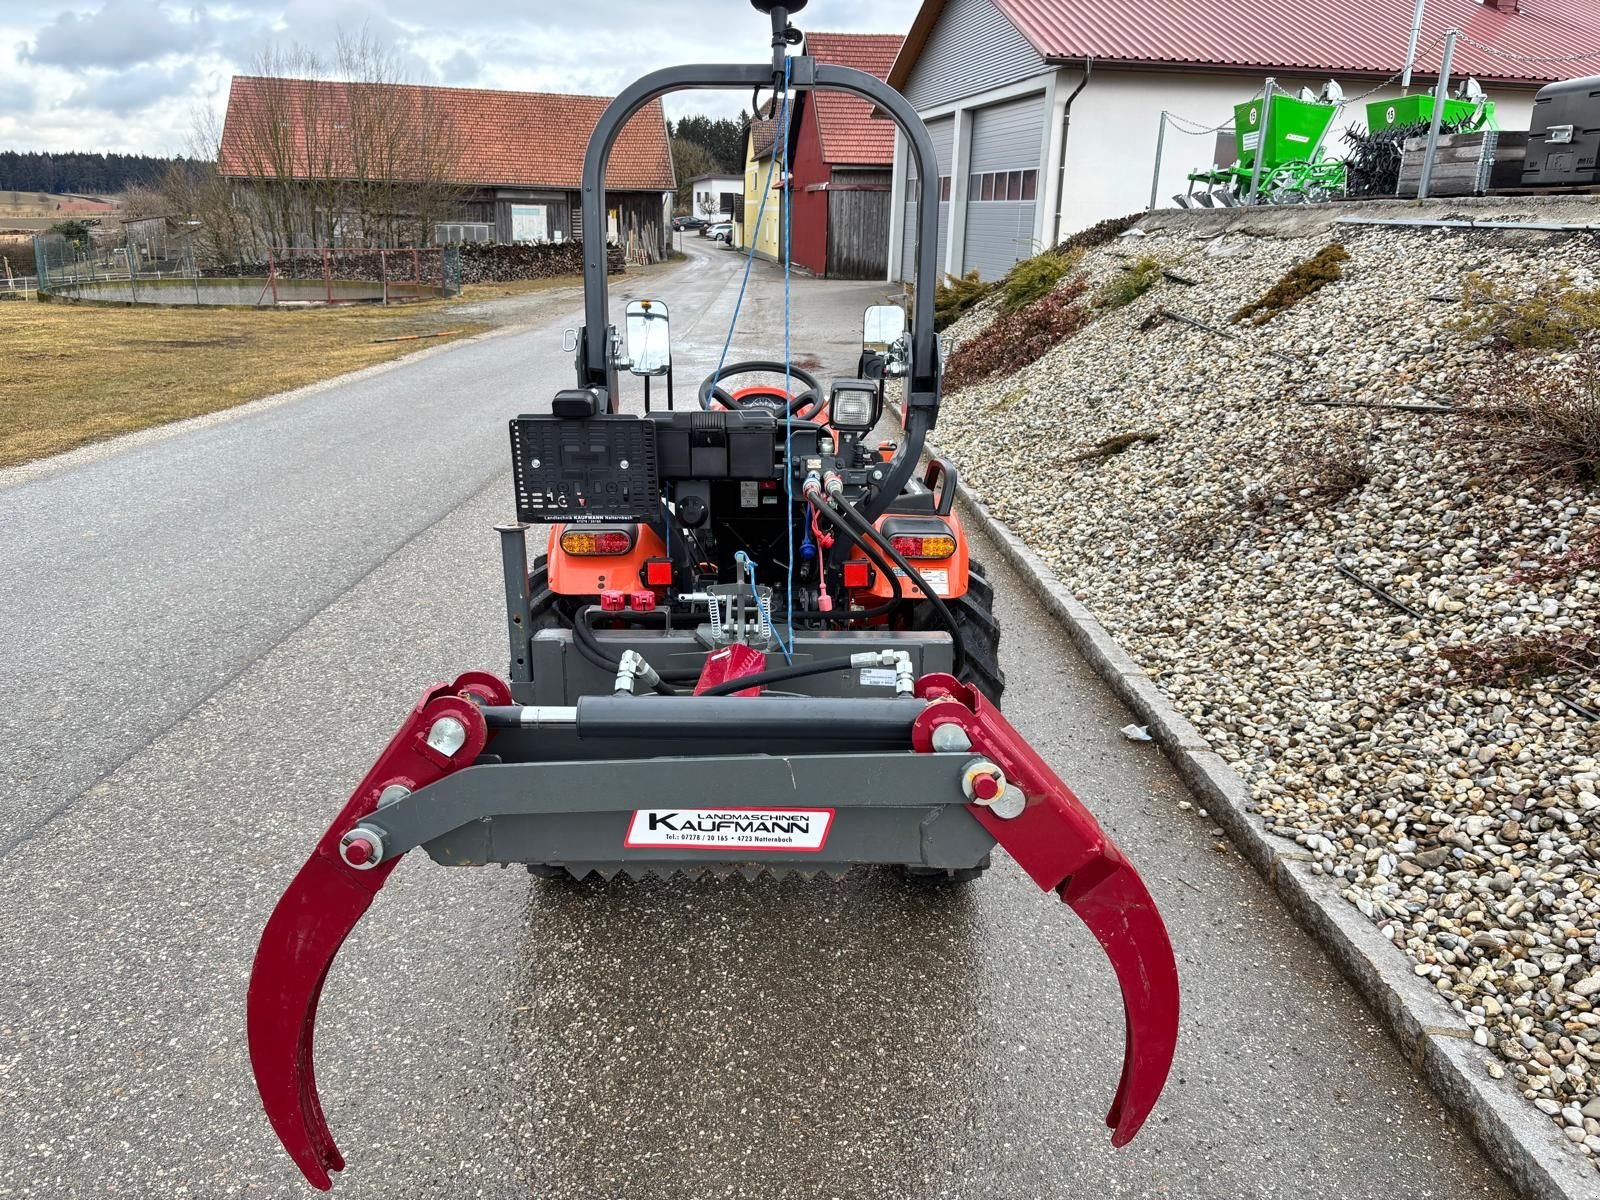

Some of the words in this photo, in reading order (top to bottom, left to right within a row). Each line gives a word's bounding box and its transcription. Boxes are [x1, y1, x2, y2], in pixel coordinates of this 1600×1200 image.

[1387, 110, 1394, 120] 15
[697, 813, 809, 821] LANDMASCHINEN
[666, 834, 680, 842] Tel.:
[681, 834, 701, 842] 07278
[707, 835, 715, 843] 20
[717, 835, 728, 843] 165
